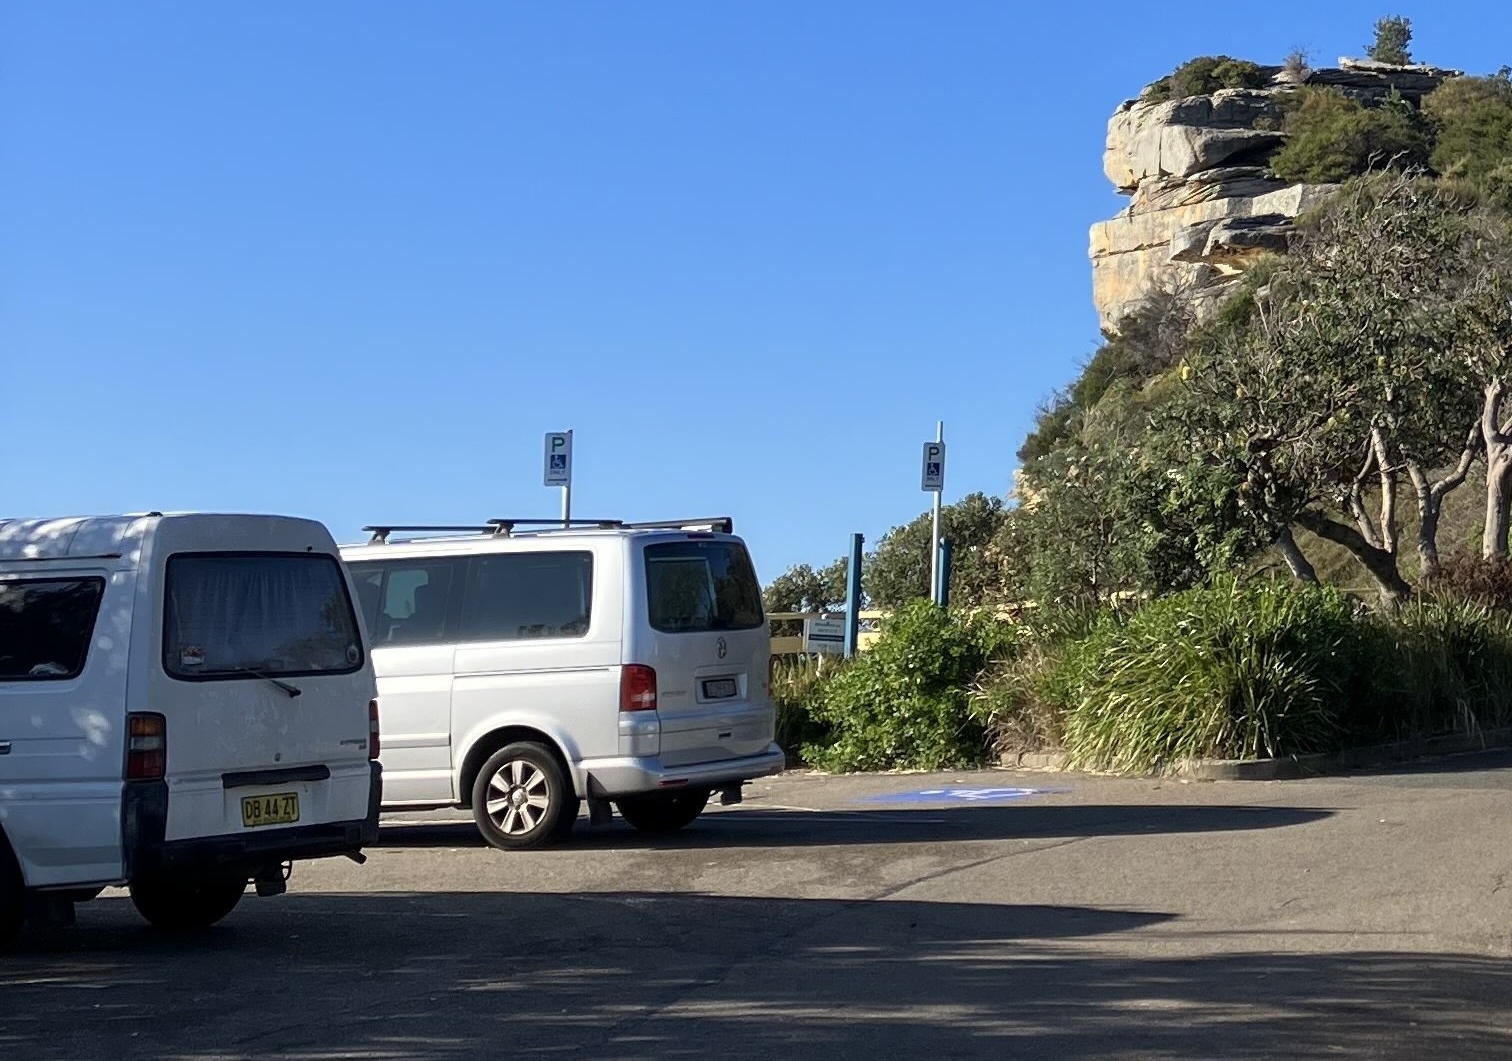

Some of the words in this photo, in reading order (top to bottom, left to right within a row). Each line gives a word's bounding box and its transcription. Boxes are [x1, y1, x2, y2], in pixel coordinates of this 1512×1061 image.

[552, 436, 565, 453] P
[928, 446, 940, 461] P
[244, 800, 262, 819] DB
[264, 798, 279, 817] 44
[281, 796, 296, 816] ZT
